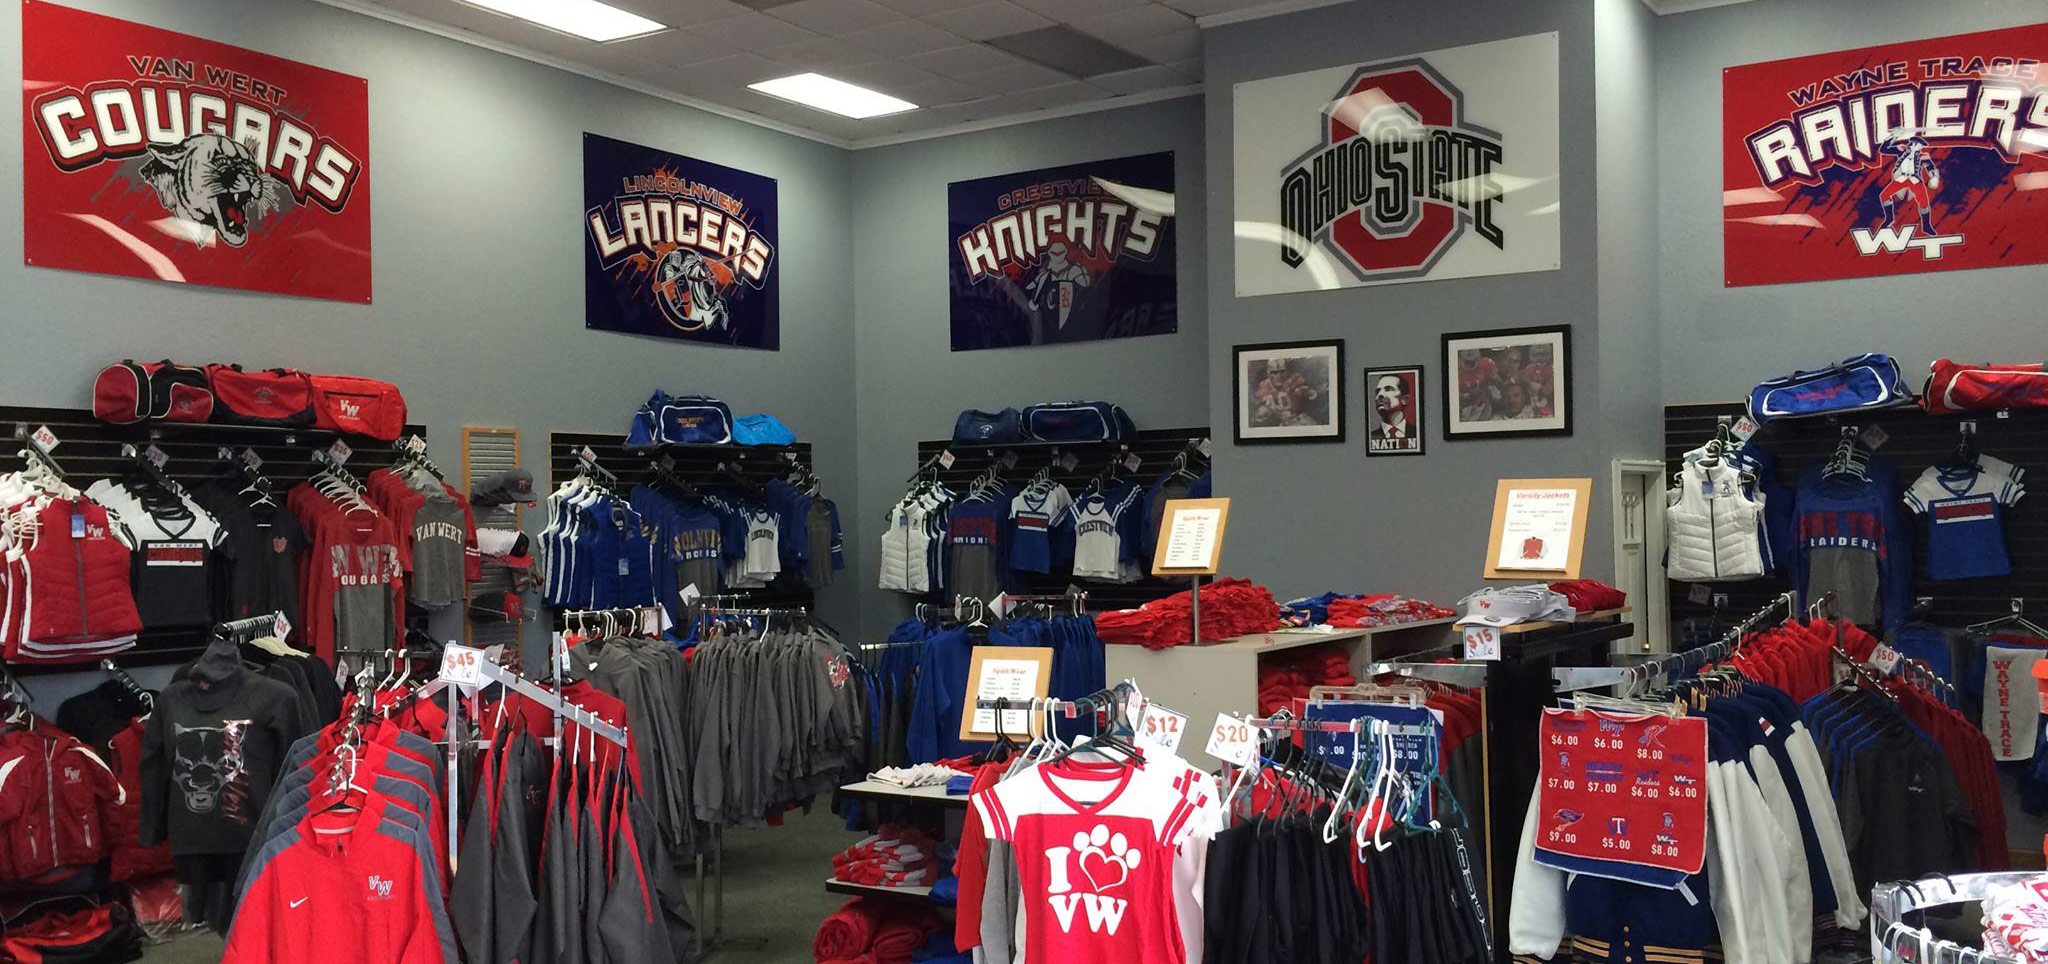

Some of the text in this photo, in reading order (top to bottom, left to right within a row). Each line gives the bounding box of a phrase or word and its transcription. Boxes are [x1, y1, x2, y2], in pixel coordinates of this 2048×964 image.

[127, 55, 287, 106] VAN WERT
[1788, 56, 2039, 107] WAYNE TRACE
[38, 84, 356, 207] COUGARS
[623, 175, 743, 215] LINCOLNVIEW
[999, 178, 1112, 211] CRESTVIE
[1281, 125, 1503, 269] OHIO STATE
[590, 200, 769, 281] LANCERS
[962, 200, 1162, 276] KNIGHTS
[1851, 225, 1964, 260] WT
[340, 399, 360, 416] VW
[1736, 421, 1753, 432] $50
[1371, 438, 1417, 450] NATIN
[416, 522, 463, 544] VAN WERT
[1467, 628, 1493, 650] $15
[447, 651, 475, 670] $45
[1876, 650, 1894, 662] $50
[1992, 660, 2012, 707] WAYNE
[1147, 715, 1178, 735] $12
[1216, 724, 1248, 743] $20
[1999, 710, 2012, 757] TRACE
[1551, 734, 1579, 745] $6.00
[1594, 737, 1623, 749] $6.00
[1318, 745, 1345, 756] $.00
[1637, 748, 1663, 760] $8.00
[1548, 778, 1575, 790] $7.00
[1587, 780, 1617, 793] $7.00
[1631, 786, 1659, 798] $6.00
[1668, 785, 1697, 798] $6.00
[1549, 831, 1577, 843] $9.00
[1602, 837, 1631, 850] $5.00
[1651, 844, 1679, 857] $8.00
[1045, 846, 1072, 894] I
[368, 874, 393, 896] VW
[1048, 892, 1128, 936] VW
